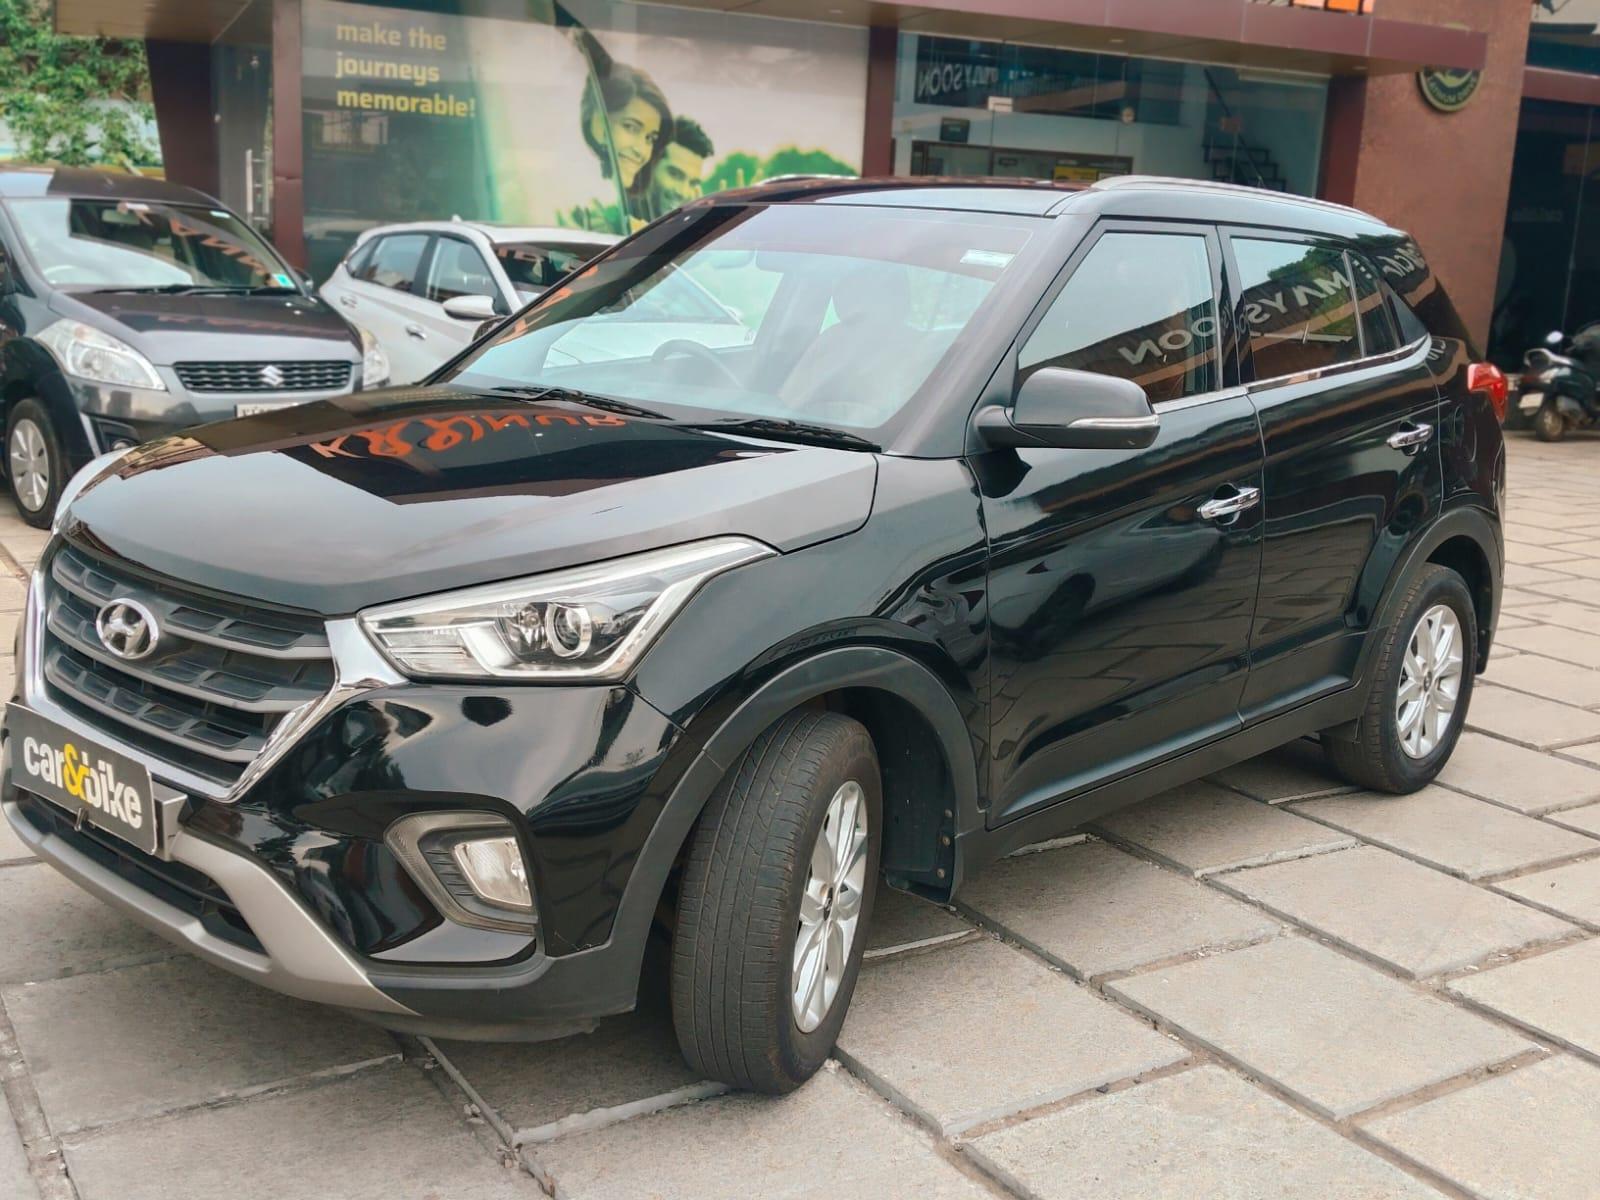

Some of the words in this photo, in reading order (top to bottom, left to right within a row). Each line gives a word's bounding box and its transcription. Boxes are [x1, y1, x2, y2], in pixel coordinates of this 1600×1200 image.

[336, 22, 401, 46] make
[408, 26, 447, 50] the
[335, 52, 440, 86] journeys
[336, 90, 476, 117] memorable!
[23, 736, 143, 829] car&bike
